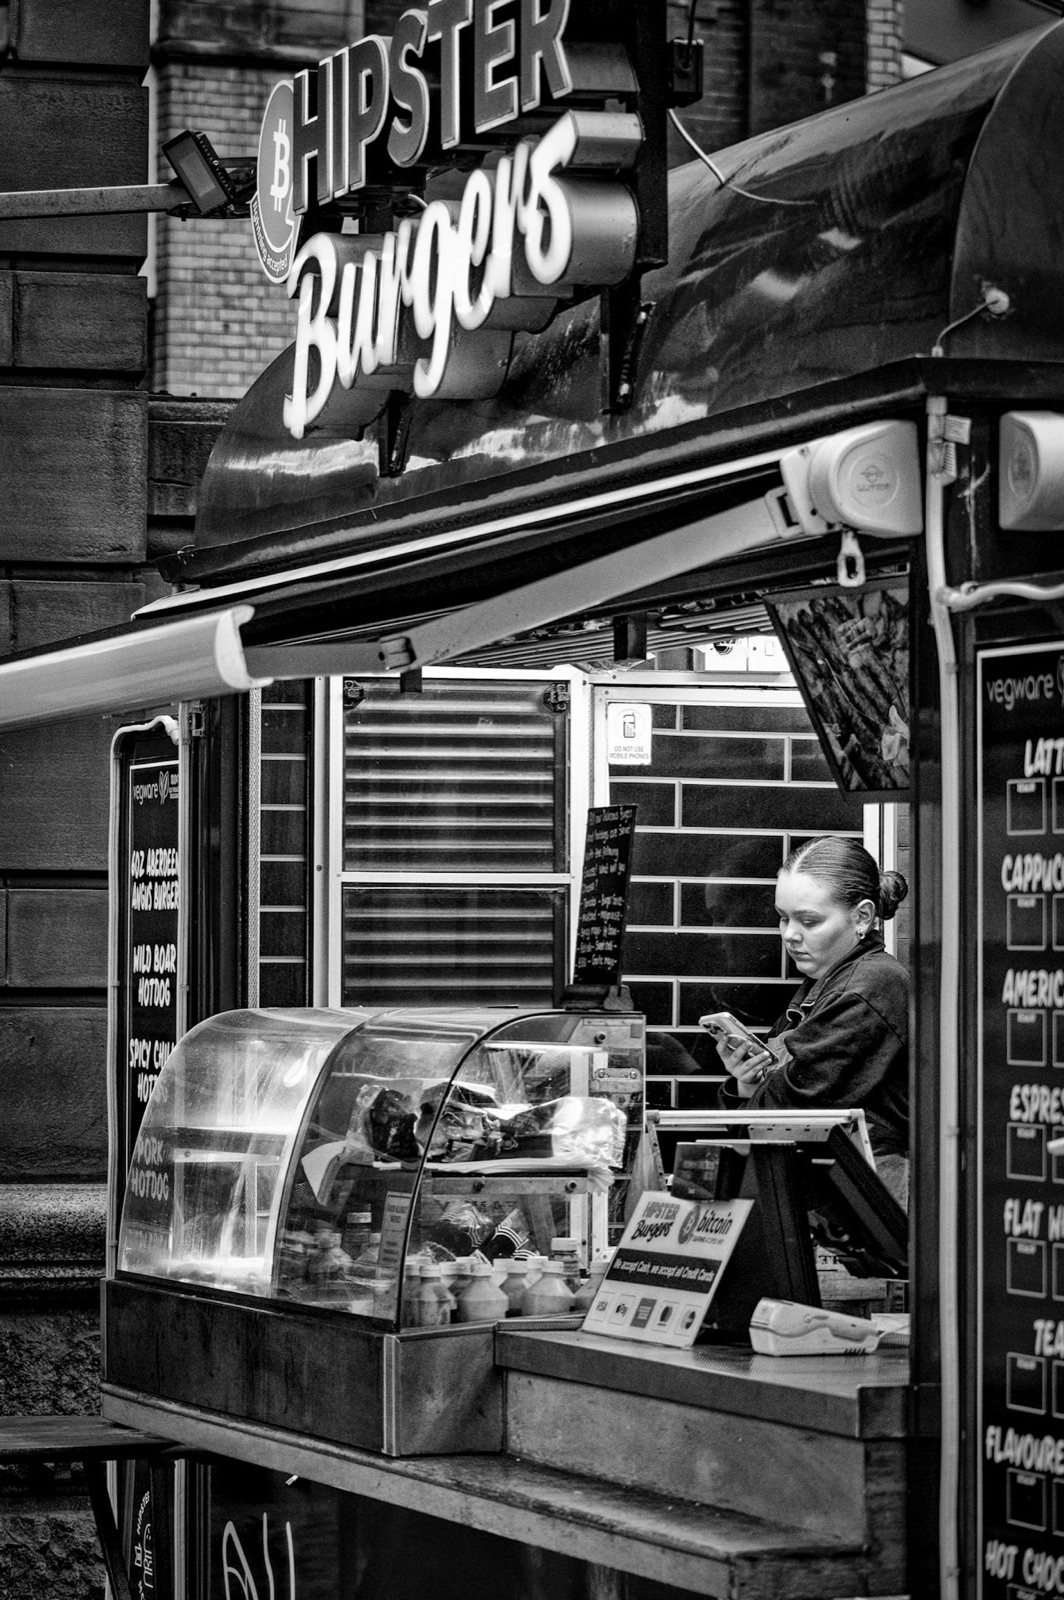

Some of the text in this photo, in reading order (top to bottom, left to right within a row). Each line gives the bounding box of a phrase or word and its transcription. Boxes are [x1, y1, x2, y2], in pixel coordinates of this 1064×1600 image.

[293, 0, 573, 216] HIPSTER
[266, 253, 288, 276] accepted
[283, 109, 579, 439] Burgers
[987, 674, 1054, 711] vegware
[634, 745, 644, 753] USE
[133, 783, 158, 805] vegware
[132, 880, 179, 911] ANGUS BURGER
[133, 943, 176, 974] WILD BOAR
[138, 977, 171, 1008] HOTDOG
[130, 1038, 151, 1069] SPICY
[1009, 1084, 1064, 1124] ESPRE
[137, 1135, 164, 1166] PORK
[131, 1168, 169, 1201] HOTDOG
[642, 1201, 680, 1220] HIPSTER
[696, 1209, 733, 1235] bitcoin
[1003, 1198, 1044, 1238] FLAT
[631, 1219, 674, 1242] Burgers
[613, 1258, 622, 1269] We
[621, 1260, 638, 1273] accept
[651, 1265, 659, 1274] we
[658, 1265, 676, 1278] accept
[682, 1267, 699, 1280] Credit
[698, 1269, 715, 1282] Cards
[985, 1539, 1019, 1580] HOT
